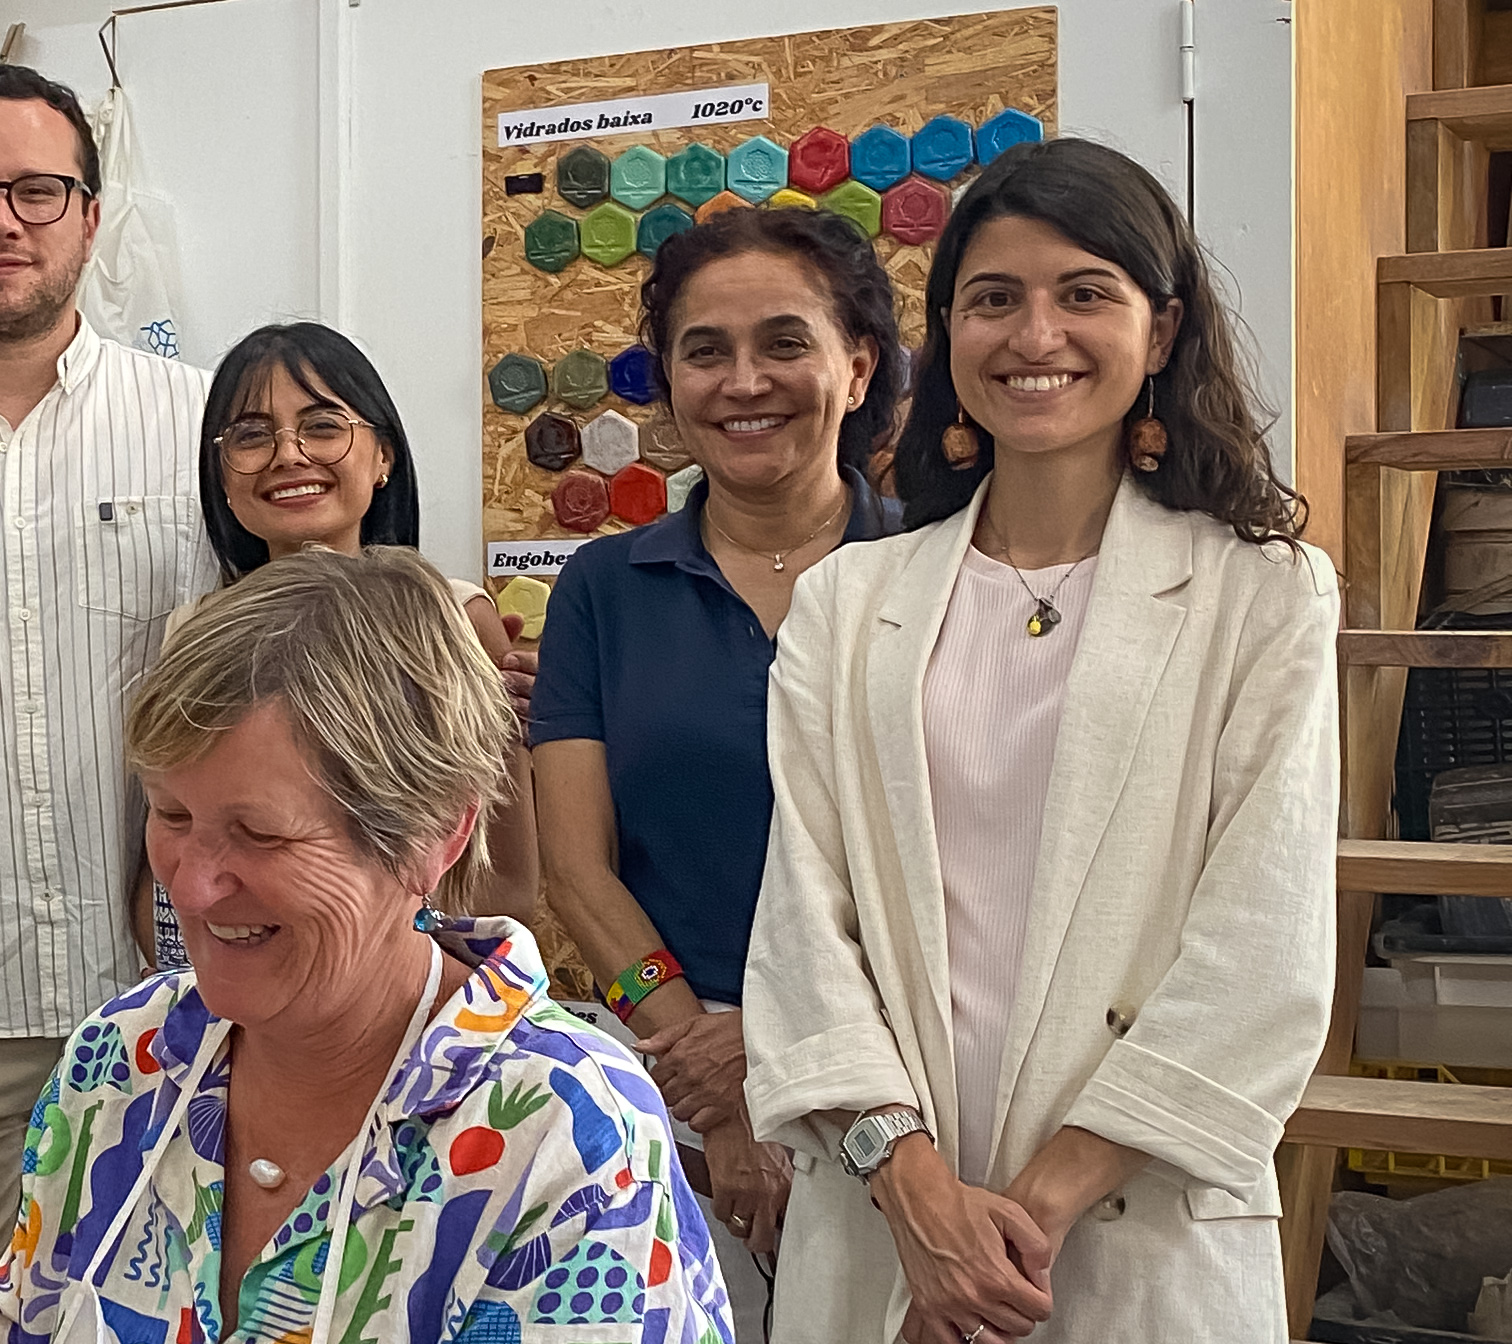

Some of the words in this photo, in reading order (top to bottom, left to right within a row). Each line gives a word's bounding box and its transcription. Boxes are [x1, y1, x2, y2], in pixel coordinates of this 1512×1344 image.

[503, 116, 593, 141] Vidrados
[596, 111, 653, 130] baixa
[493, 550, 575, 571] Engobe
